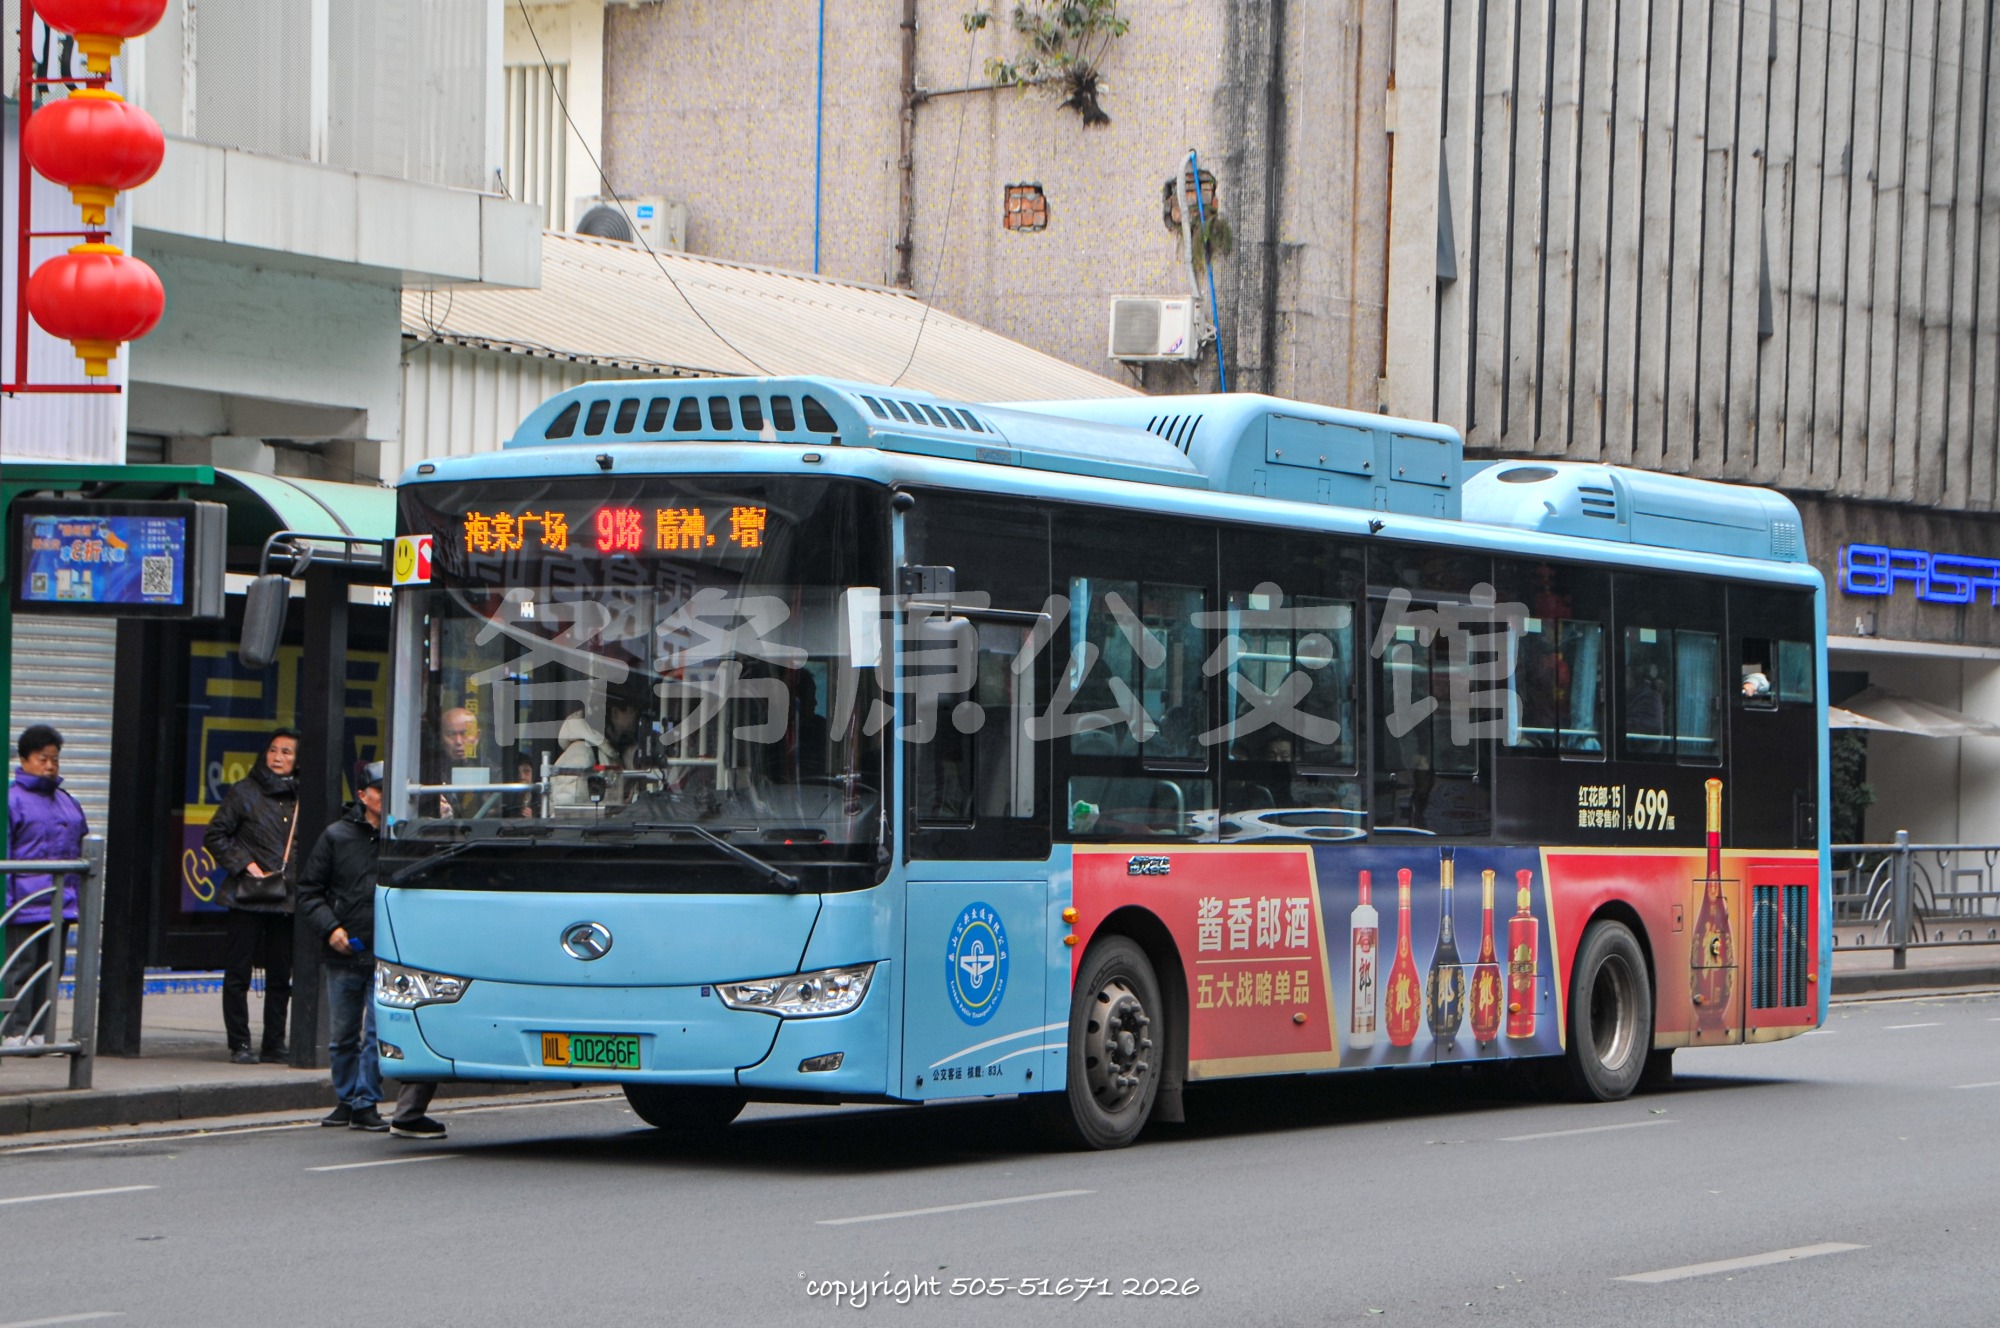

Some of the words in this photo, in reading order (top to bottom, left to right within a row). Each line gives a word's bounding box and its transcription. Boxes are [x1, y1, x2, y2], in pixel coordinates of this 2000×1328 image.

[464, 510, 569, 552] 海棠广场
[597, 508, 643, 551] 9路
[1578, 809, 1621, 828] 建议零售价
[1197, 896, 1311, 952] 酱香郎酒
[1196, 969, 1310, 1009] 五大战略单品
[932, 1067, 962, 1081] 公交客运
